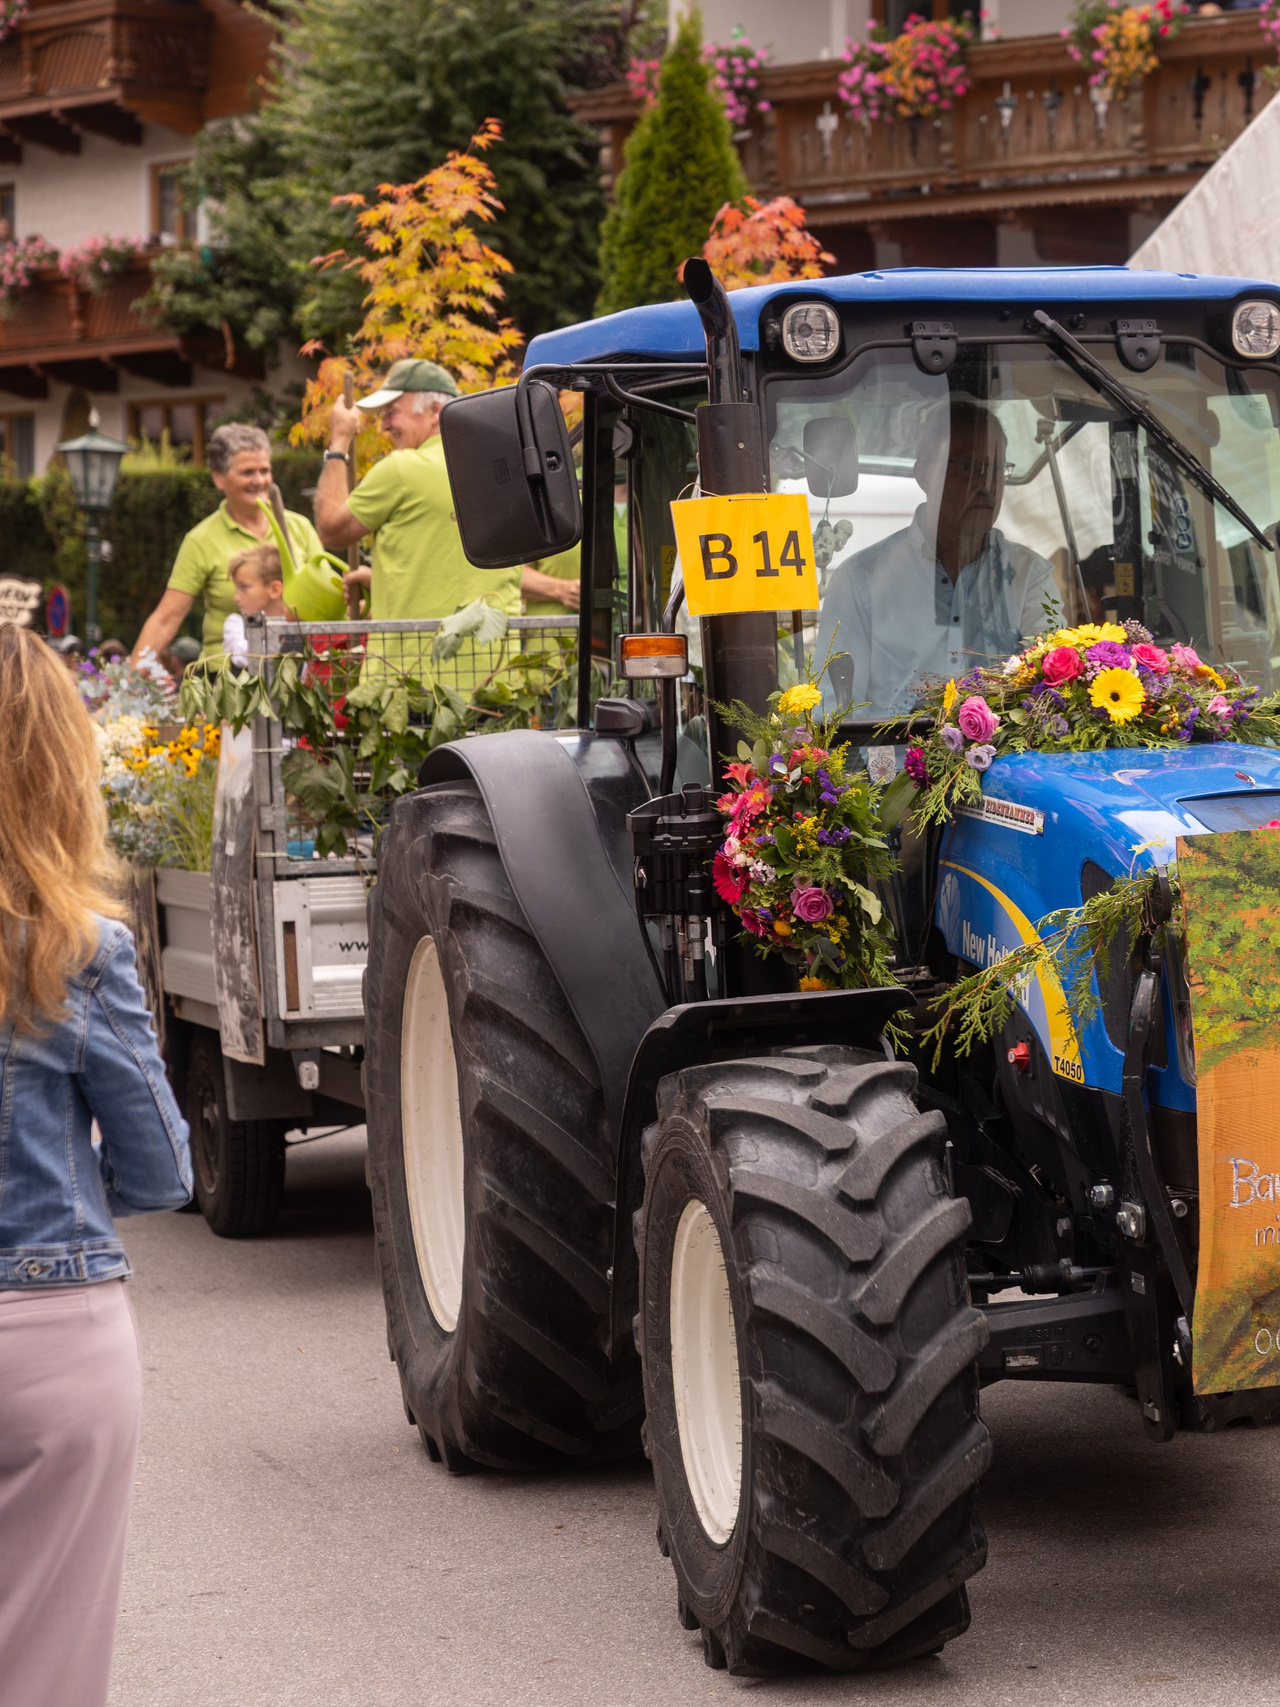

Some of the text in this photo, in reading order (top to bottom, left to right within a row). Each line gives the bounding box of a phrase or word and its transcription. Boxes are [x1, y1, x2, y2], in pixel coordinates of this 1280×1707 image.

[698, 530, 807, 581] B 14
[962, 919, 1031, 1012] New Hond
[1054, 1055, 1082, 1080] T4050
